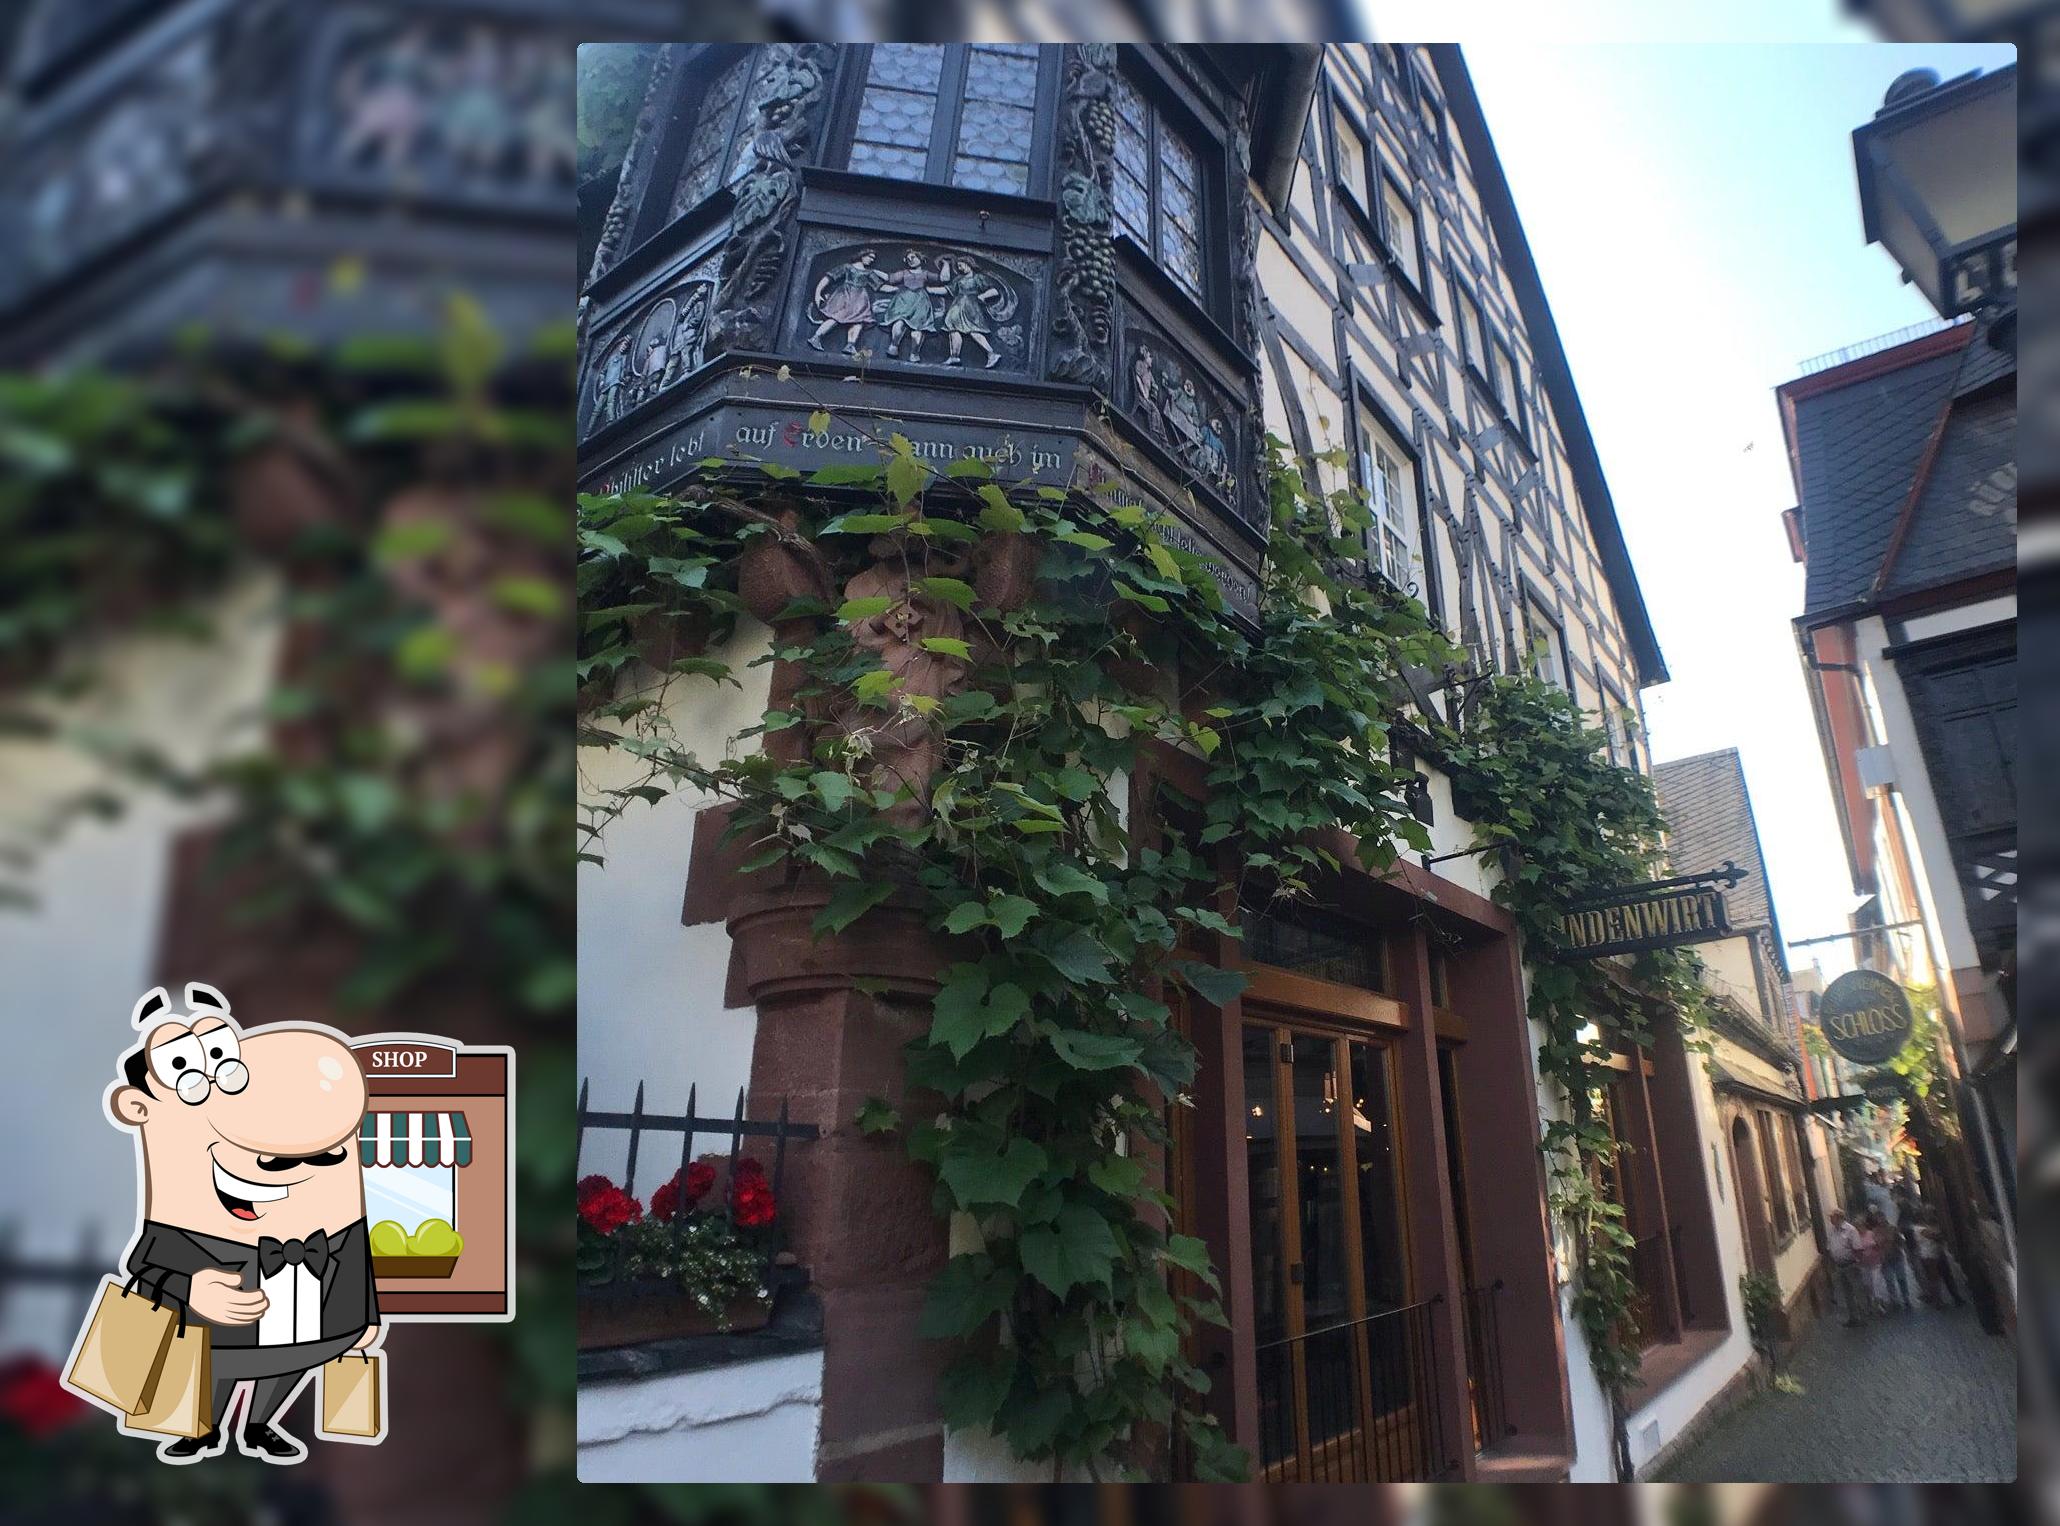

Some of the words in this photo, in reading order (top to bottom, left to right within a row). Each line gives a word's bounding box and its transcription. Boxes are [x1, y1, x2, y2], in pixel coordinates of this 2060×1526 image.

[735, 421, 779, 450] auf
[911, 440, 955, 459] ann
[1830, 1003, 1907, 1041] SCHLOSS
